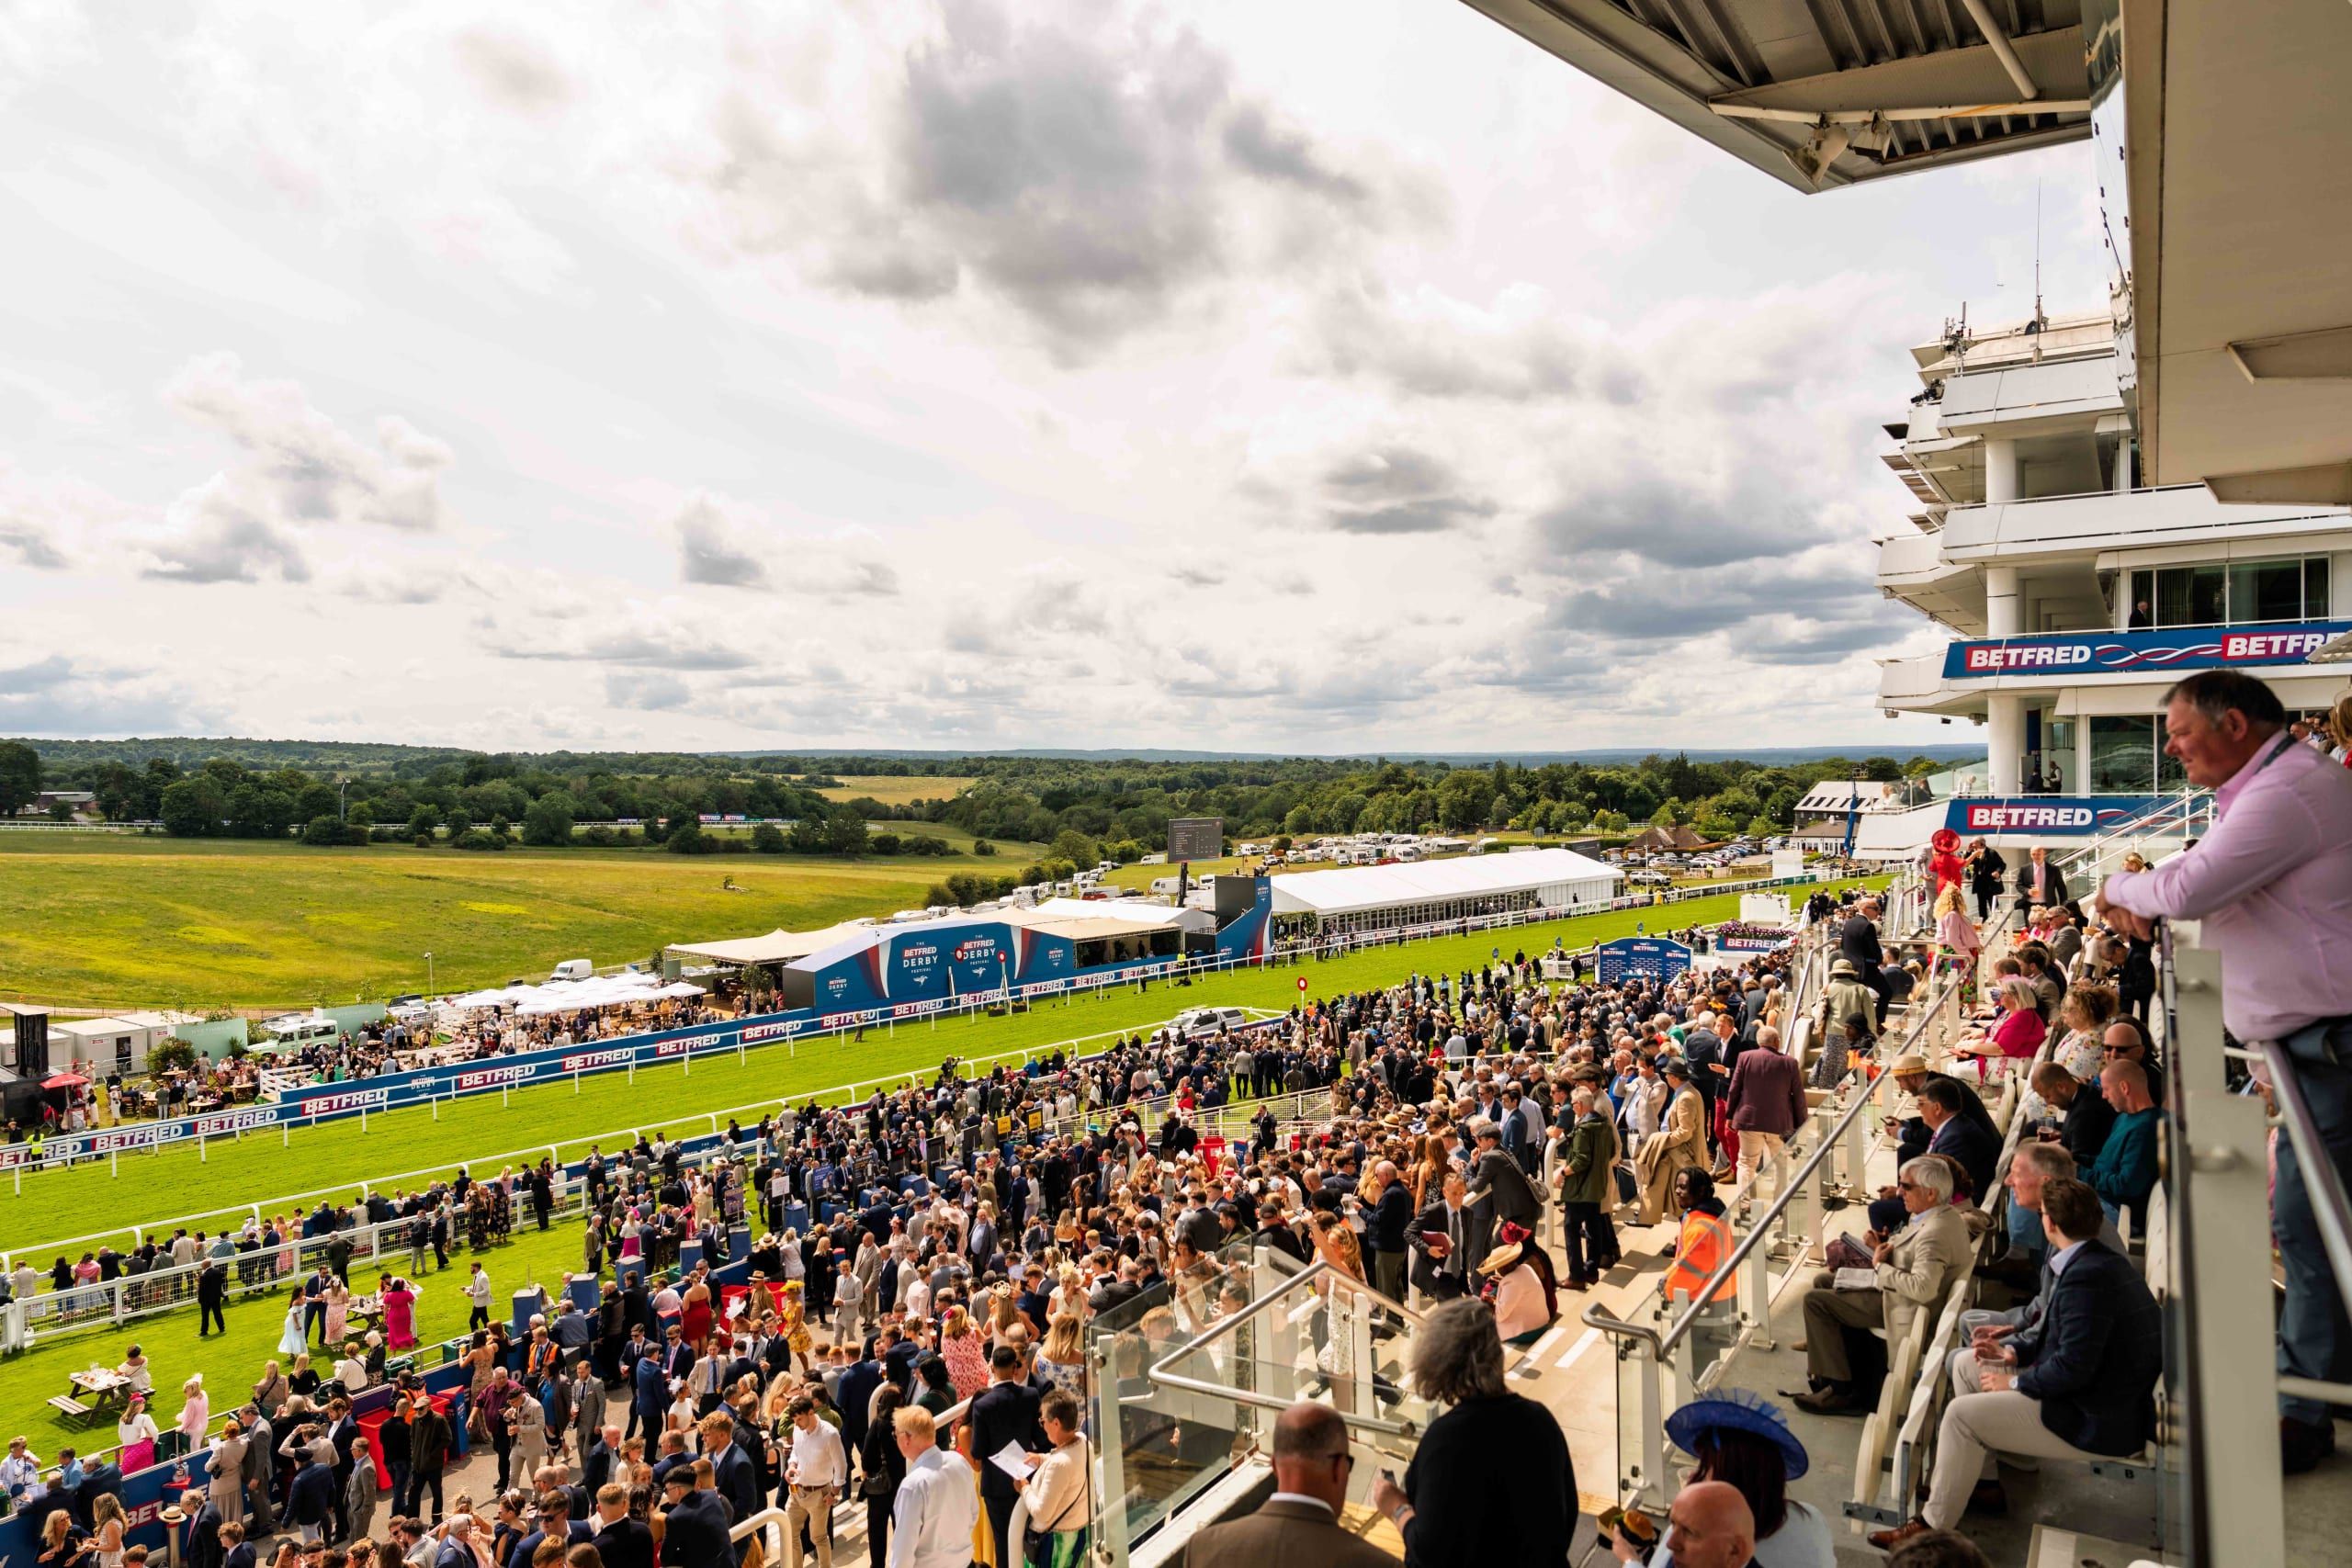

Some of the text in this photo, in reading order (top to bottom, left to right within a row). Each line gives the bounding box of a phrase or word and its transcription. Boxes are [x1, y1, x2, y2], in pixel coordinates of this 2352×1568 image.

[1970, 646, 2091, 668] BETFRED
[1973, 807, 2093, 826] BETFRED
[904, 946, 937, 957] BETFRED
[964, 939, 995, 950] BETFRED
[1726, 938, 1778, 949] BETFRED
[903, 955, 938, 968] DERBY
[963, 948, 996, 960] DERBY
[1023, 980, 1065, 994] BETFRED
[1075, 973, 1114, 987] BETFRED
[744, 1020, 801, 1039] BETFRED
[658, 1033, 720, 1055] BETFRED
[565, 1048, 633, 1069] BETFRED
[462, 1066, 536, 1087] BETFRED
[305, 1089, 388, 1113] BETFRED
[197, 1109, 277, 1134] BETFRED
[96, 1124, 183, 1151] BETFRED
[0, 1141, 83, 1167] ETRED
